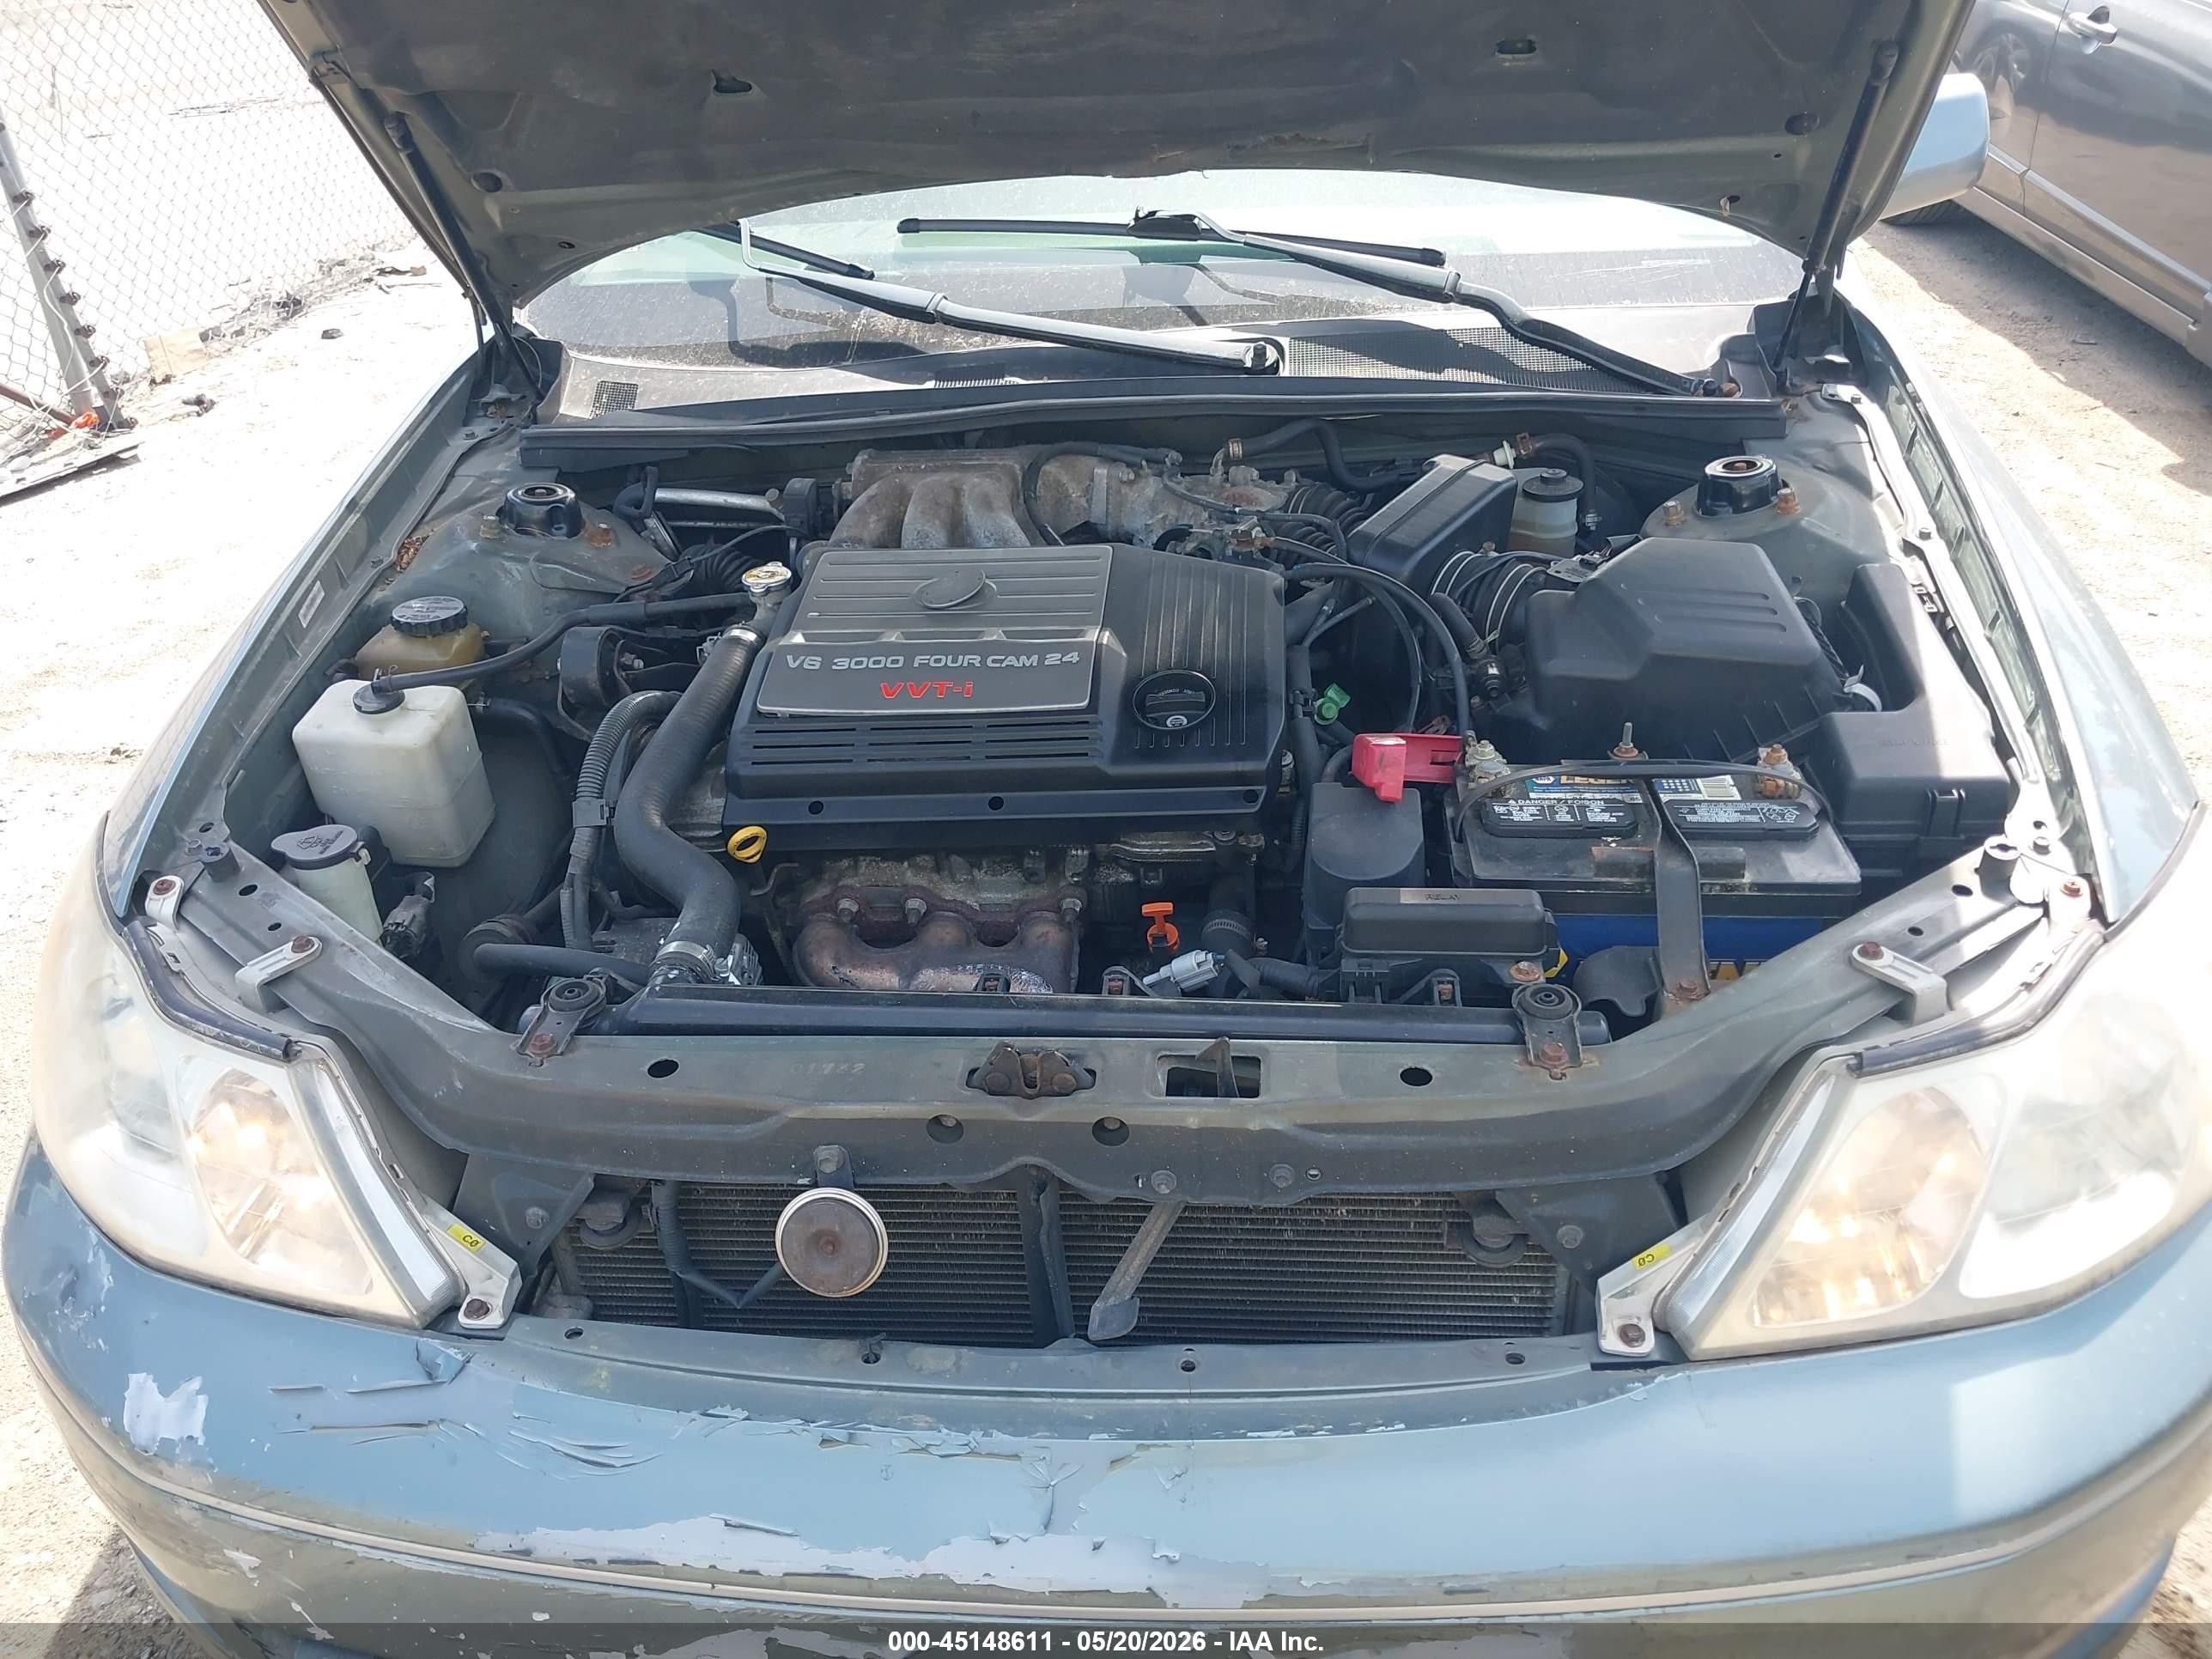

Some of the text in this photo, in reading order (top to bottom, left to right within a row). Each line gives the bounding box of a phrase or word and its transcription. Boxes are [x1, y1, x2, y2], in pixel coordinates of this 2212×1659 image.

[786, 651, 1080, 670] V6 3000 FOUR CAM 24
[880, 681, 975, 699] VVT-i
